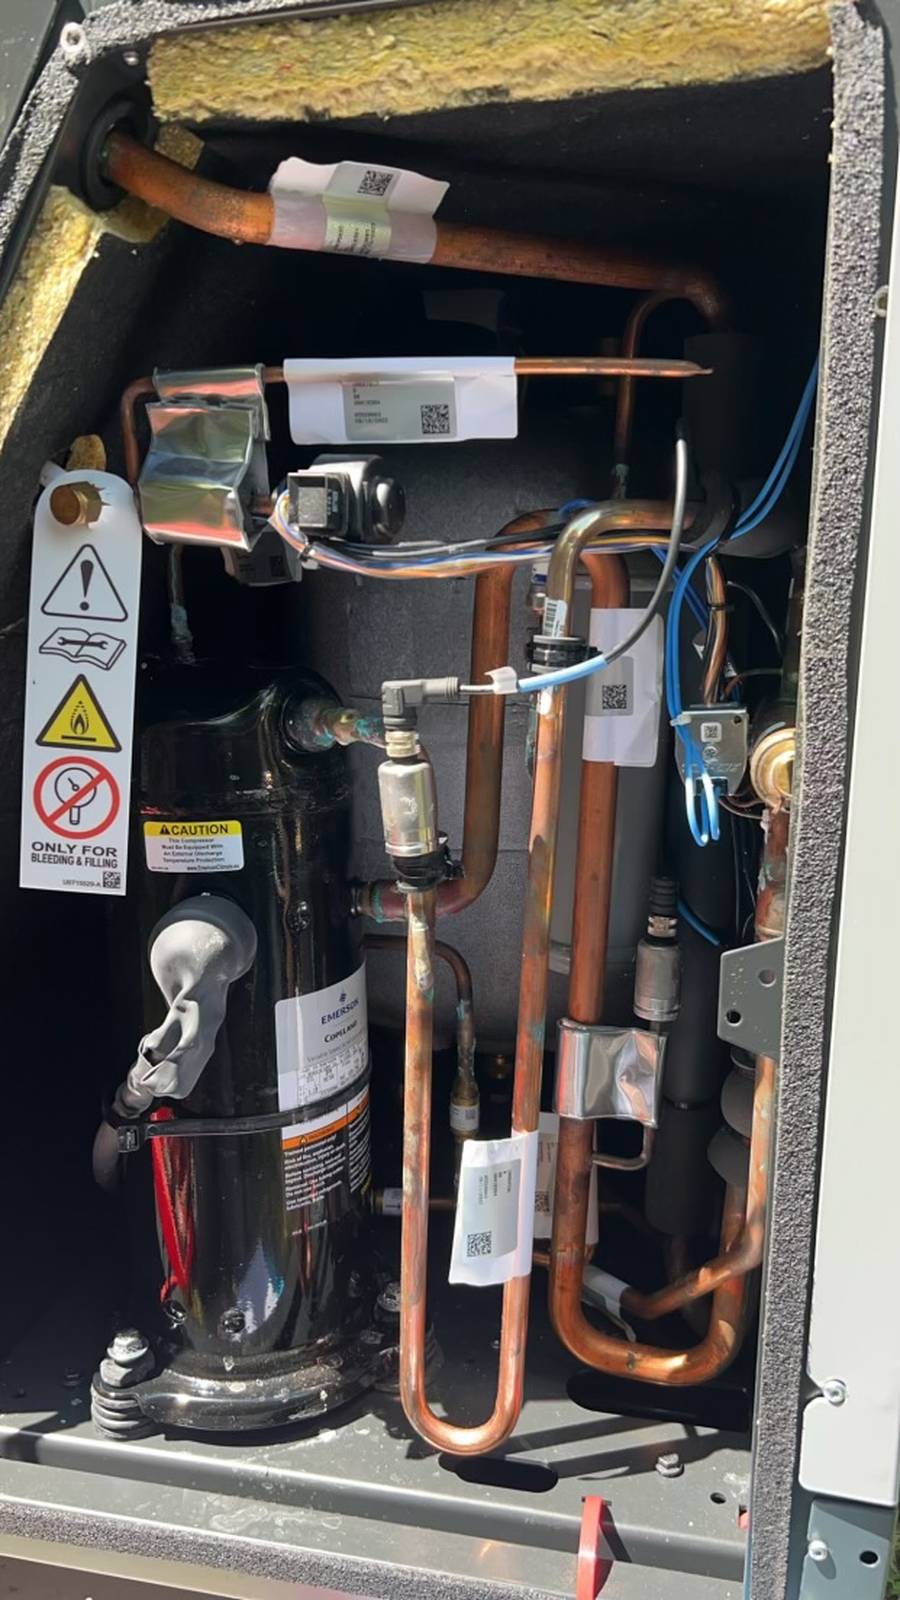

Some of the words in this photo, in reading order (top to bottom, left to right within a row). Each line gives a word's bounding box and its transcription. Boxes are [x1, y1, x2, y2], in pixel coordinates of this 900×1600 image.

[171, 824, 228, 835] CAUTION
[31, 841, 77, 854] ONLY
[82, 845, 118, 857] FOR
[31, 853, 74, 866] BLEEDING
[76, 856, 82, 866] &
[84, 857, 118, 869] FILLING
[321, 998, 360, 1025] EMERSON
